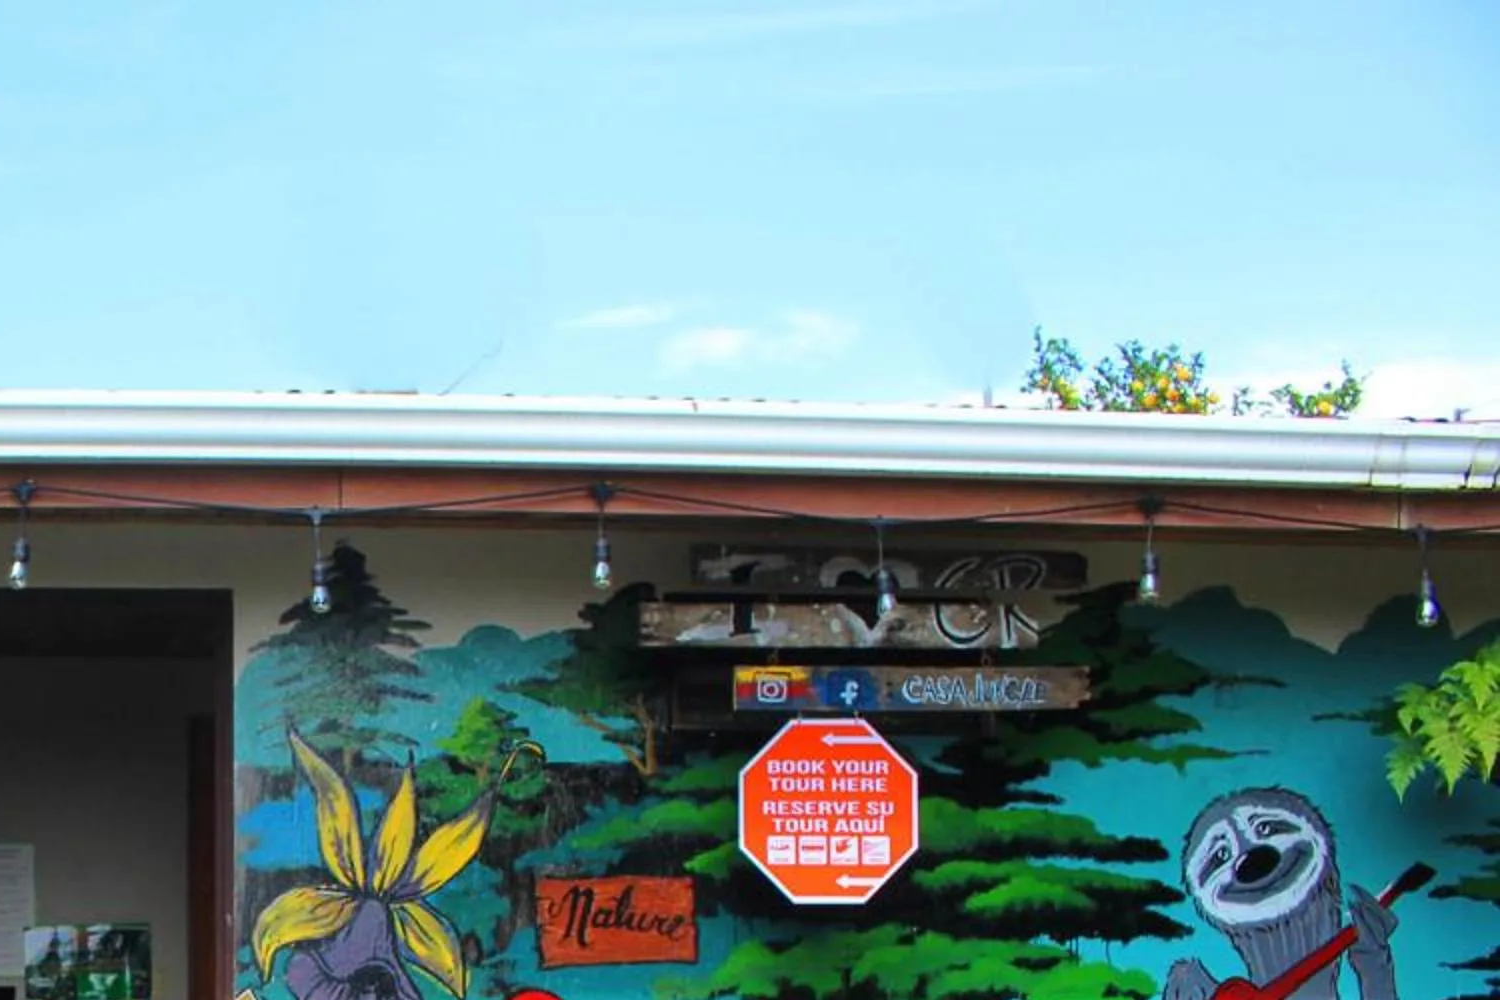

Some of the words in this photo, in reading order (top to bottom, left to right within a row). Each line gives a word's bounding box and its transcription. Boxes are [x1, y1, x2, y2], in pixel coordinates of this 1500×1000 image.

[932, 556, 1046, 650] CR
[902, 674, 966, 706] CASA
[767, 760, 826, 775] BOOK
[831, 760, 890, 775] YOUR
[770, 777, 826, 793] TOUR
[831, 777, 888, 793] HERE
[763, 801, 861, 816] RESERVE
[866, 801, 895, 816] SU
[773, 818, 829, 834] TOUR
[835, 815, 886, 834] AQUÍ
[547, 884, 686, 948] Nature
